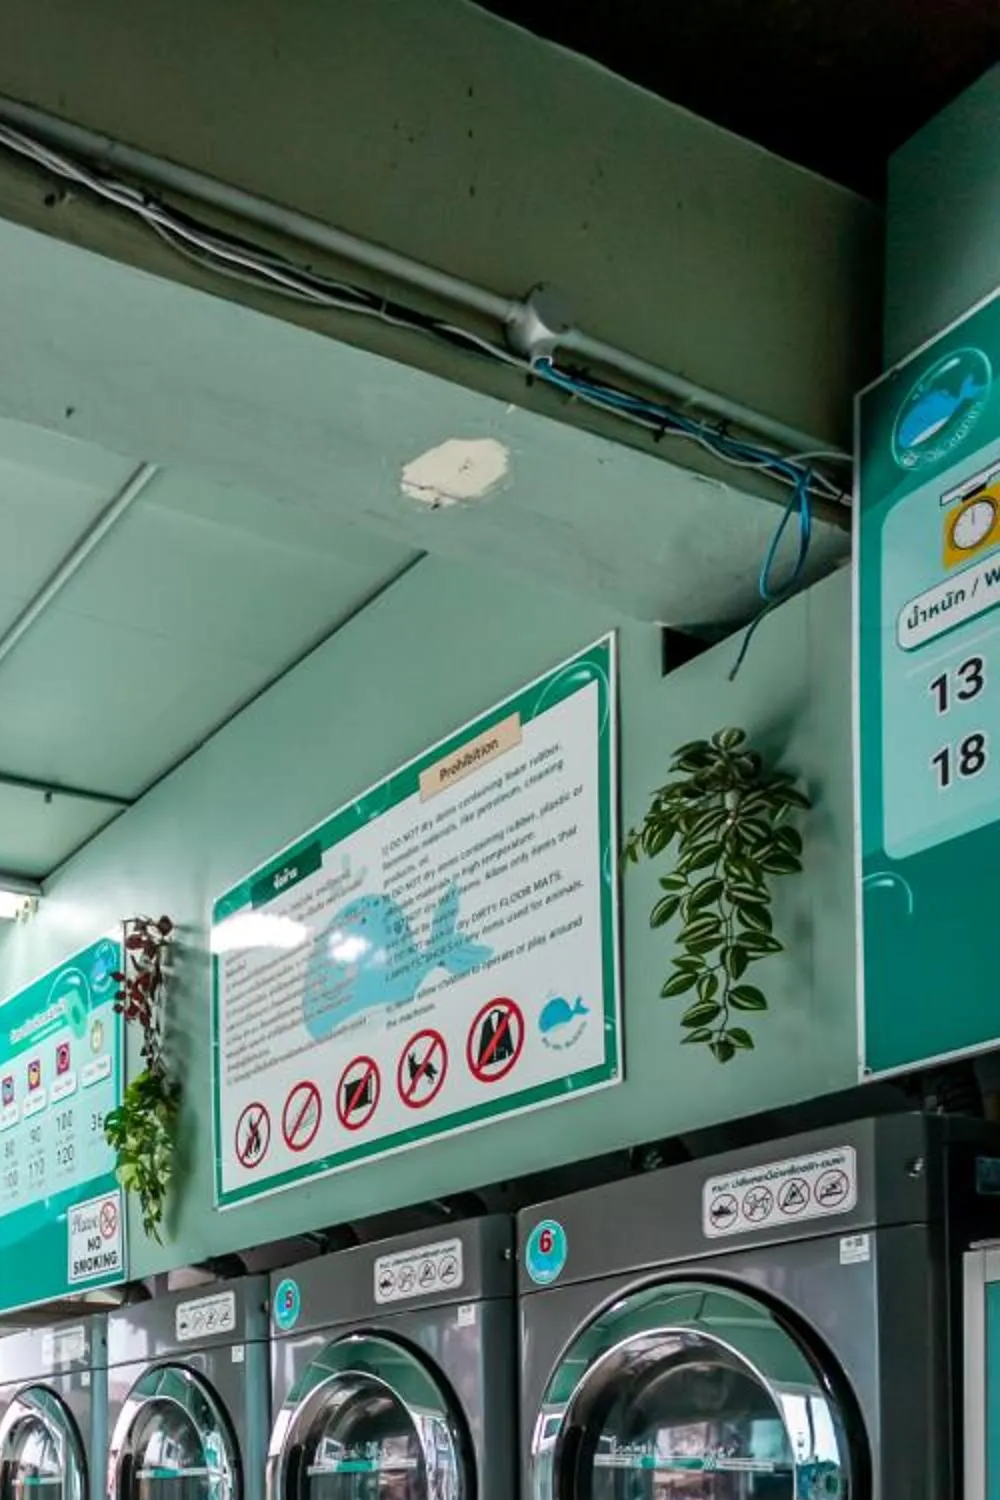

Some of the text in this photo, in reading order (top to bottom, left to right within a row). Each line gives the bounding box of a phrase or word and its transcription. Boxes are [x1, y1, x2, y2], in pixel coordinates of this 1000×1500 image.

[907, 588, 966, 630] น้ำหนัก
[930, 656, 984, 714] 13
[439, 738, 500, 782] Prohibition
[932, 733, 986, 787] 18
[402, 825, 419, 842] NOT
[405, 875, 421, 890] NOT
[472, 903, 496, 922] DIRTY
[499, 885, 531, 908] FLOOR
[507, 905, 528, 923] used
[549, 915, 582, 939] around
[87, 1235, 101, 1252] NO
[540, 1229, 553, 1253] 6
[73, 1250, 118, 1276] SMOKING
